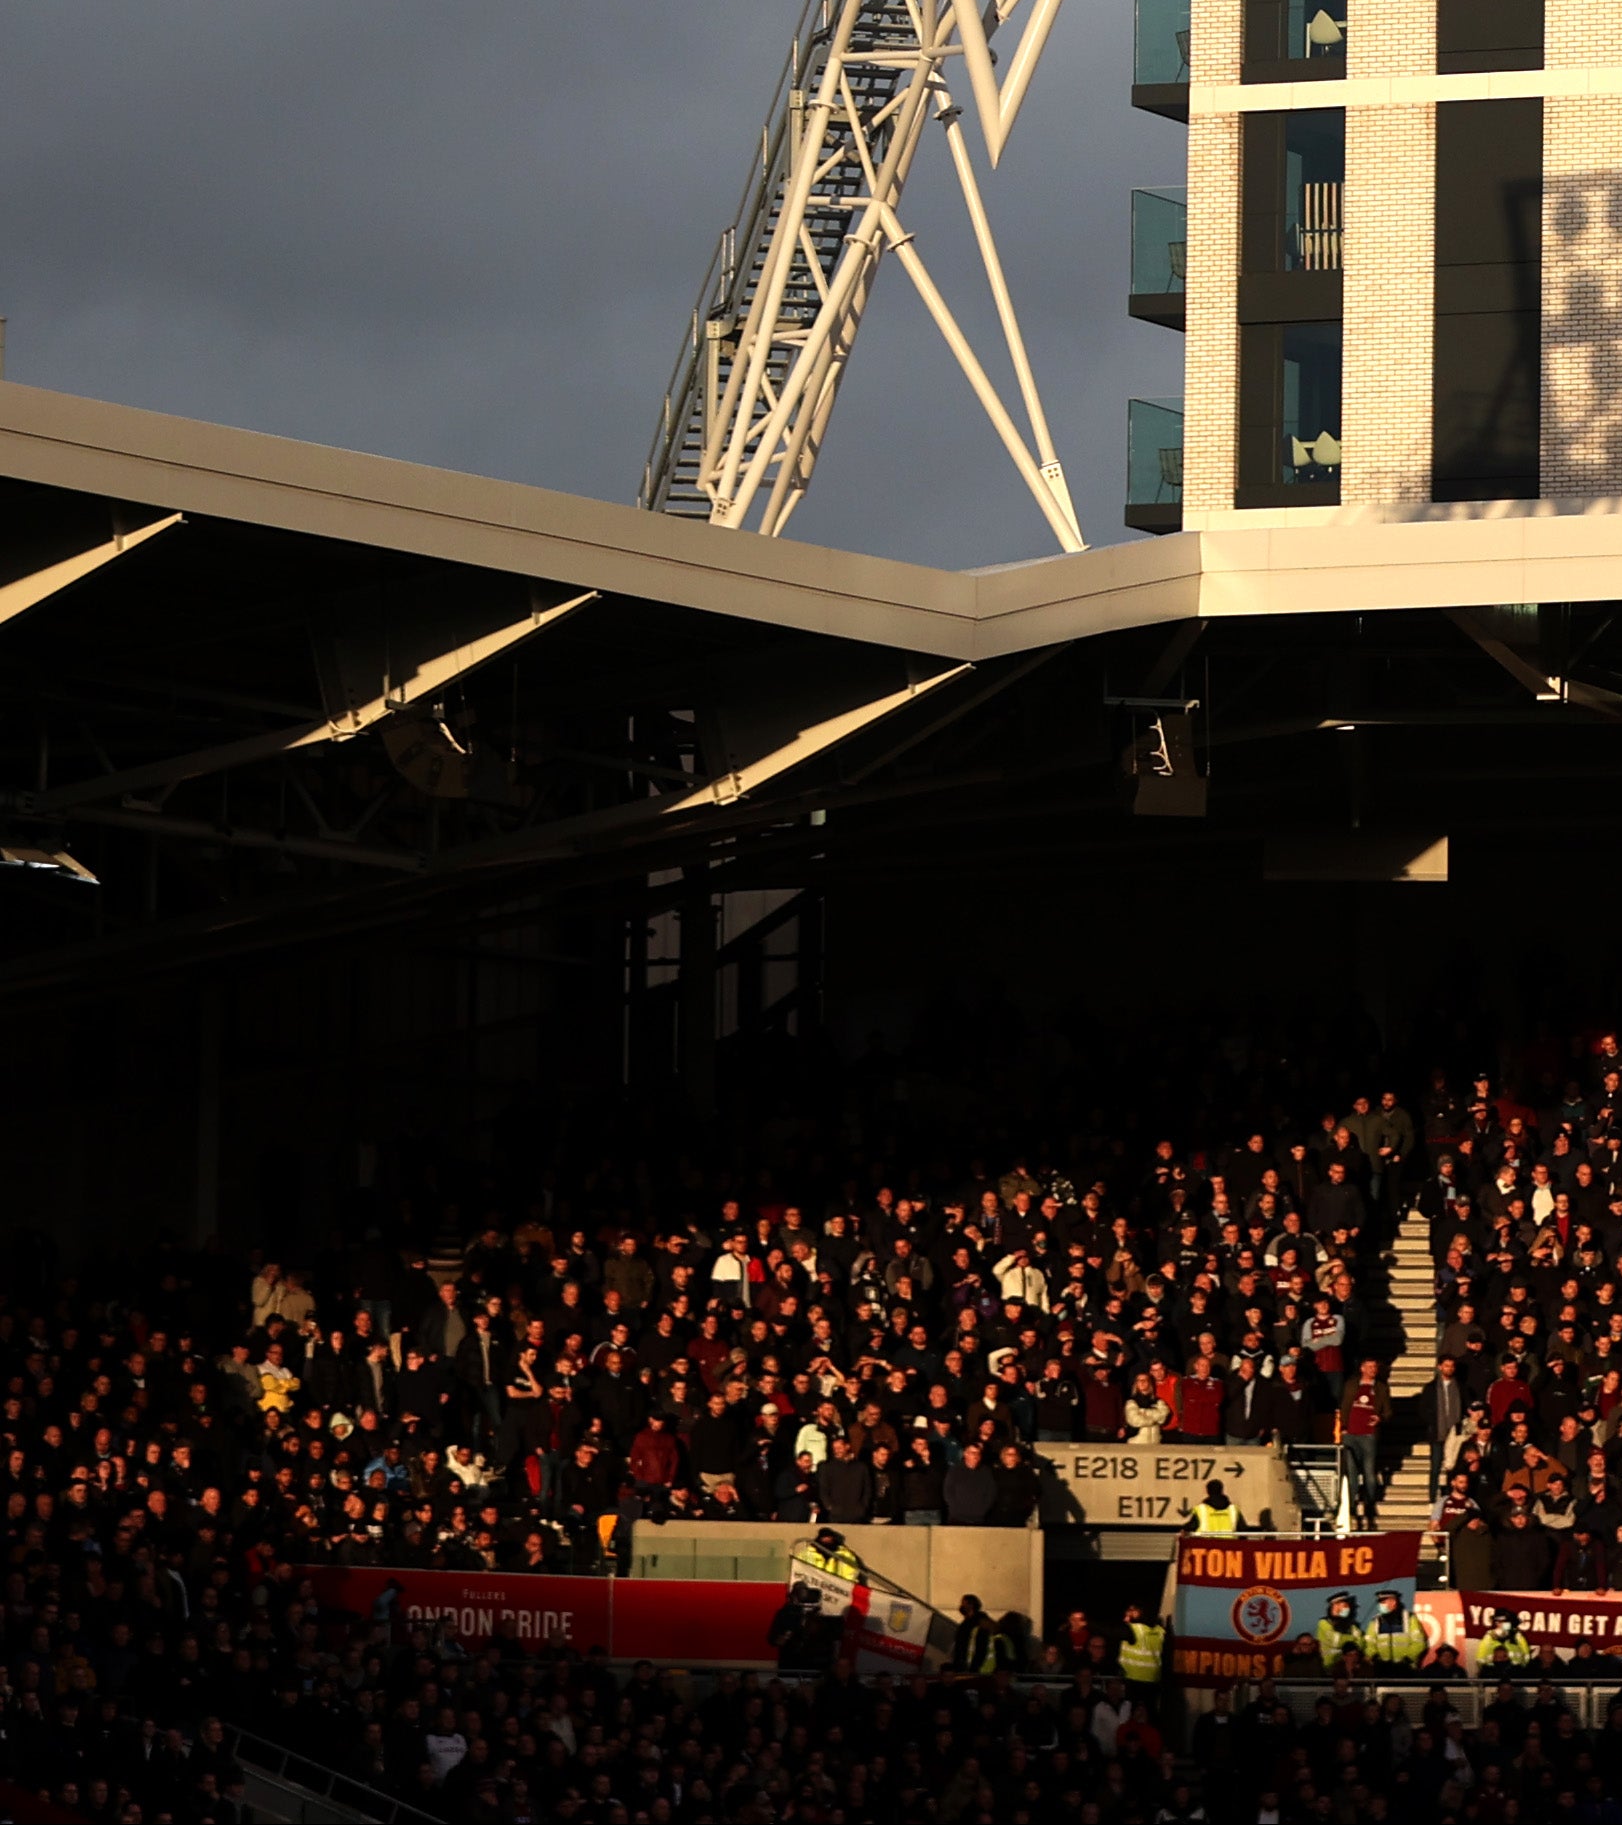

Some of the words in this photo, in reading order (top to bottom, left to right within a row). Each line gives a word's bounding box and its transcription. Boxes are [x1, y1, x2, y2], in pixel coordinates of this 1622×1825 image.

[1075, 1456, 1138, 1479] E218
[1156, 1458, 1216, 1480] E217
[1119, 1496, 1171, 1519] E117
[1254, 1550, 1328, 1580] VILLA
[1338, 1545, 1374, 1576] FC
[1518, 1610, 1561, 1634] CAN
[1567, 1613, 1610, 1637] GET
